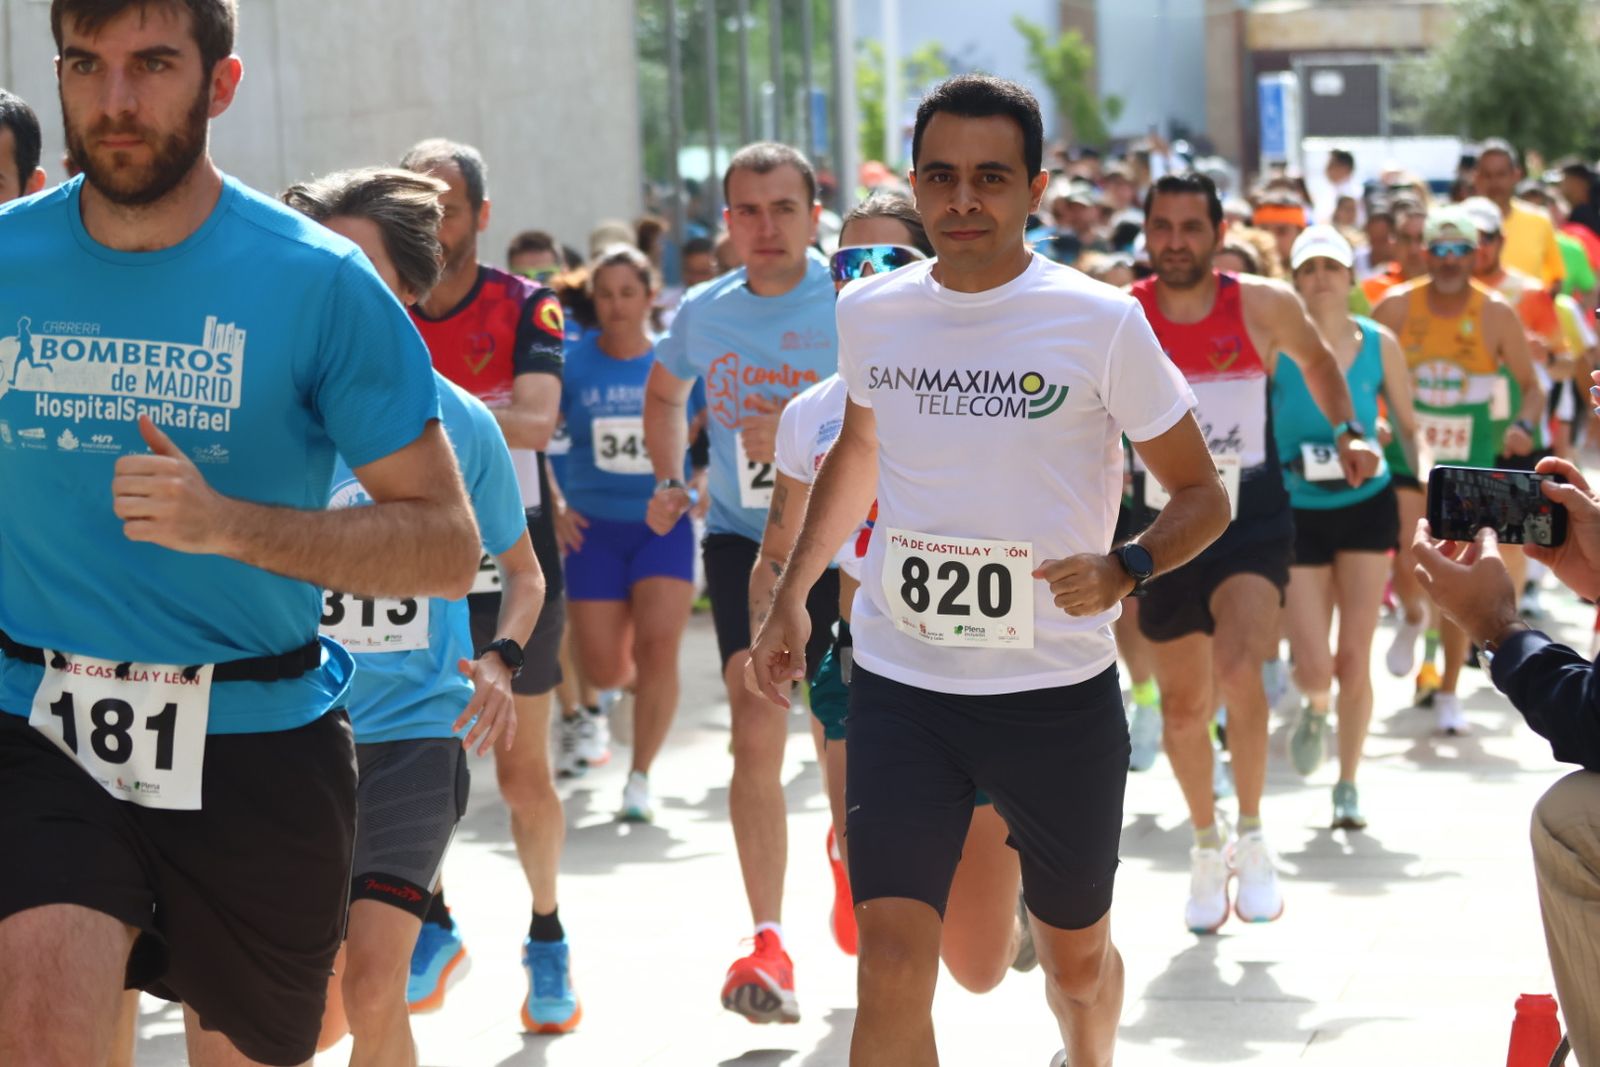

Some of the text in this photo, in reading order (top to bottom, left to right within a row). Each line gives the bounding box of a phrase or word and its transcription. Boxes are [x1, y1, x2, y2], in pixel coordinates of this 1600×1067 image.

[42, 320, 101, 335] CARRERA
[40, 337, 233, 375] BOMBEROS
[111, 365, 233, 403] de MADRID
[743, 363, 818, 388] contra
[868, 366, 1045, 395] SANMAXIMO
[35, 393, 231, 432] HospitalSanRafael
[914, 393, 1027, 418] TELECOM
[911, 539, 924, 550] DE
[926, 542, 981, 557] CASTILLA
[983, 547, 991, 556] Y
[1004, 547, 1028, 558] ÓN
[901, 556, 1012, 618] 820
[964, 625, 985, 633] Plena
[65, 663, 82, 675] DE
[86, 664, 149, 682] CASLLA
[150, 671, 160, 682] Y
[50, 691, 178, 770] 181
